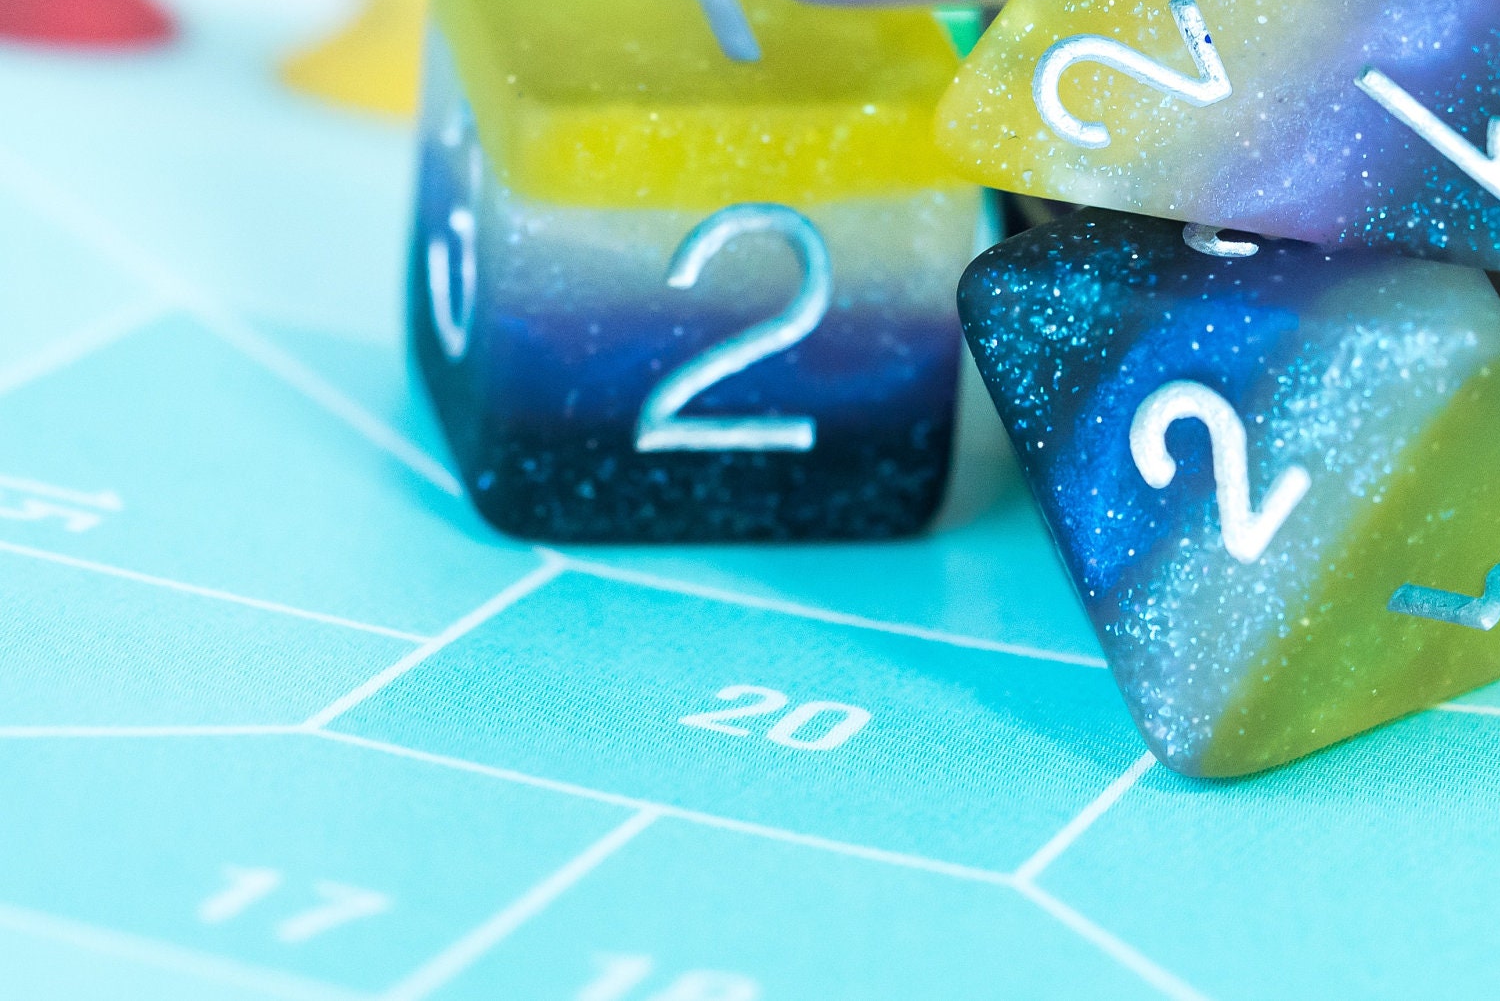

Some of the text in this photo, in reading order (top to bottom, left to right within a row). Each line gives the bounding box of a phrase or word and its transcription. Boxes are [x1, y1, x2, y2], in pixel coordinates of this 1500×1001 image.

[634, 201, 833, 453] 2
[1128, 380, 1312, 565] 2
[678, 684, 873, 752] 20
[197, 863, 394, 945] 17
